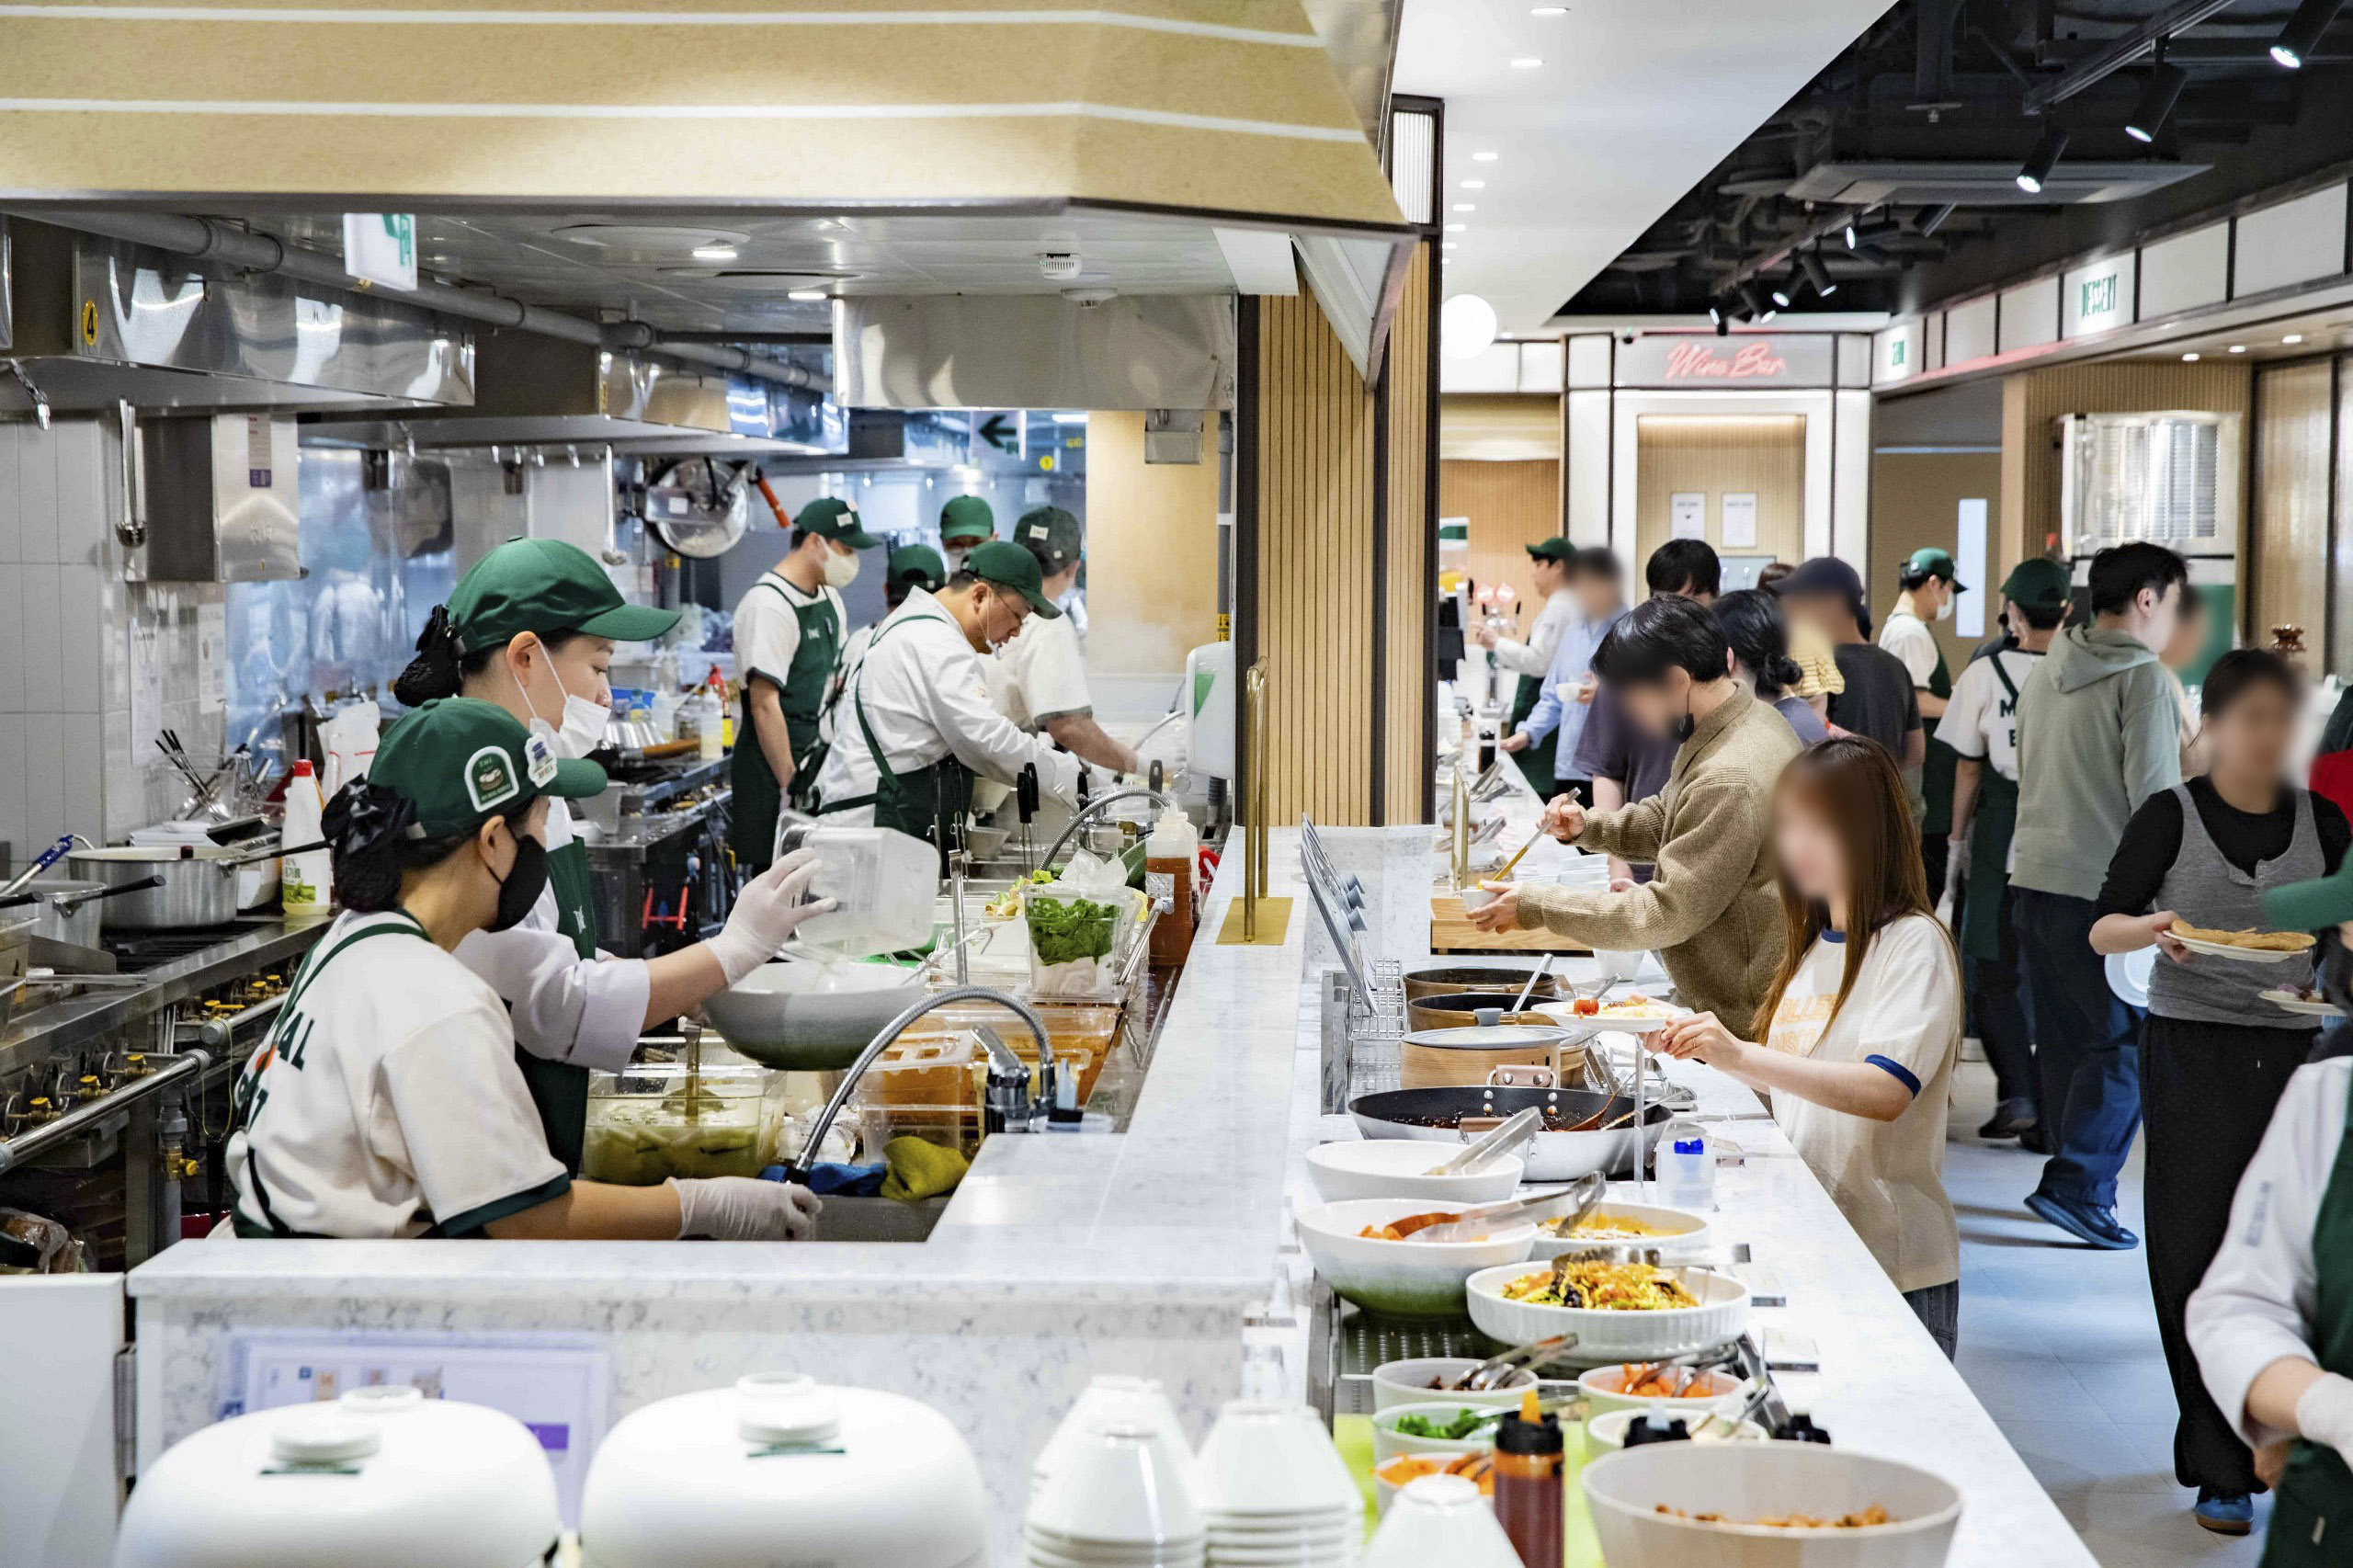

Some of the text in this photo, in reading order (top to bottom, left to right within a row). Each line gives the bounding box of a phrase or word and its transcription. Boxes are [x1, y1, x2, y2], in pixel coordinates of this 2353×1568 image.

[86, 307, 95, 339] 4
[1665, 341, 1786, 380] Wine Bar
